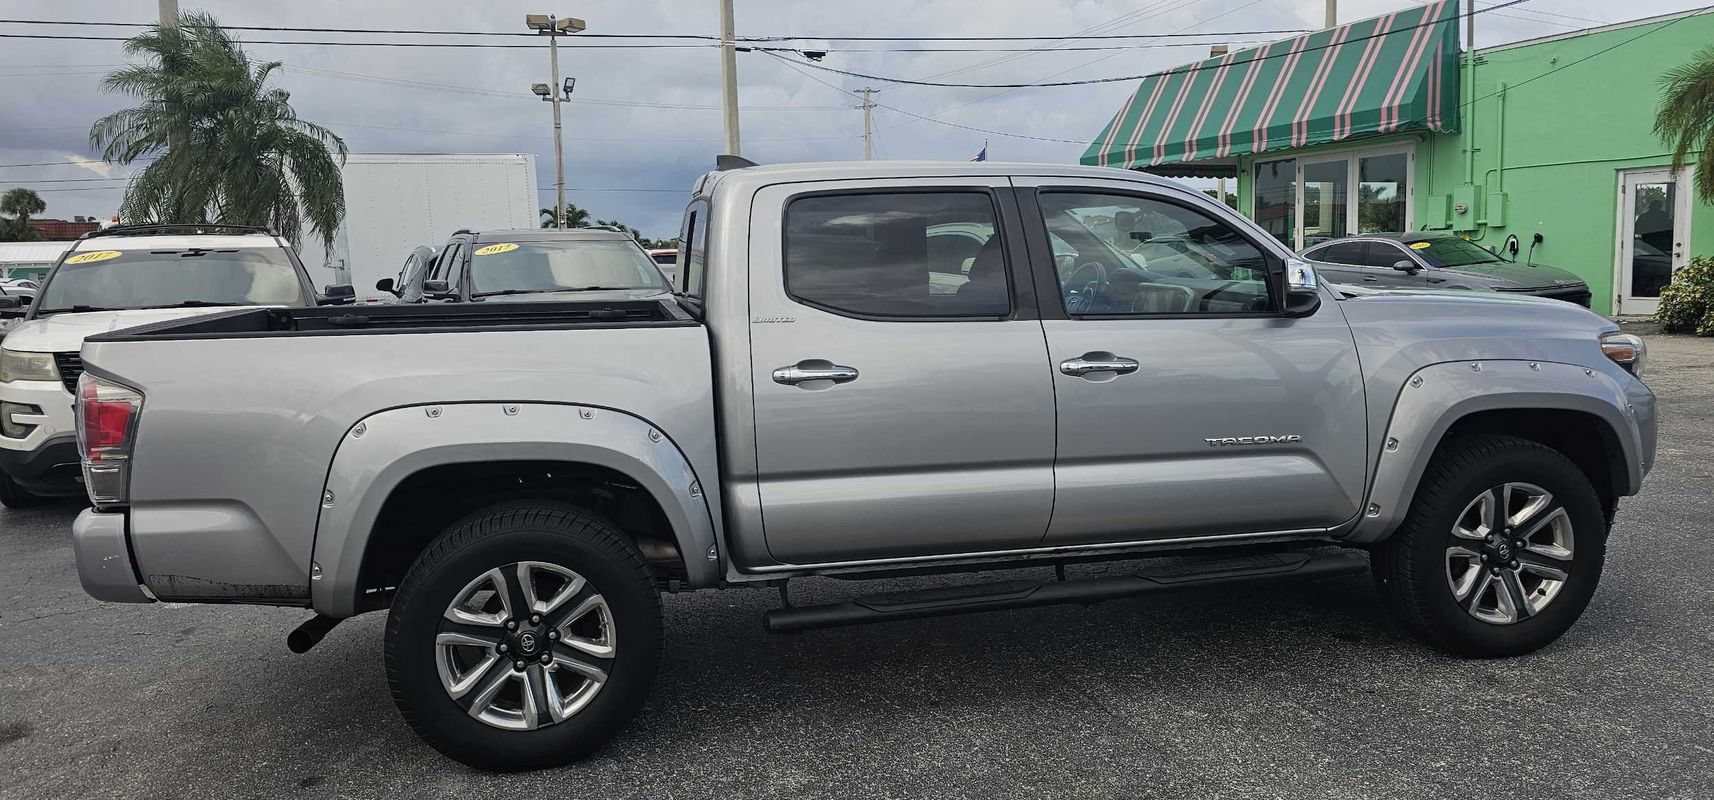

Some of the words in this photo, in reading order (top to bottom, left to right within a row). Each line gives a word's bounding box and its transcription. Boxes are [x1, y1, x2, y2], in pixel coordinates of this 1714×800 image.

[481, 244, 512, 254] 2017
[74, 252, 116, 262] 2017
[1204, 434, 1302, 446] TACOMA
